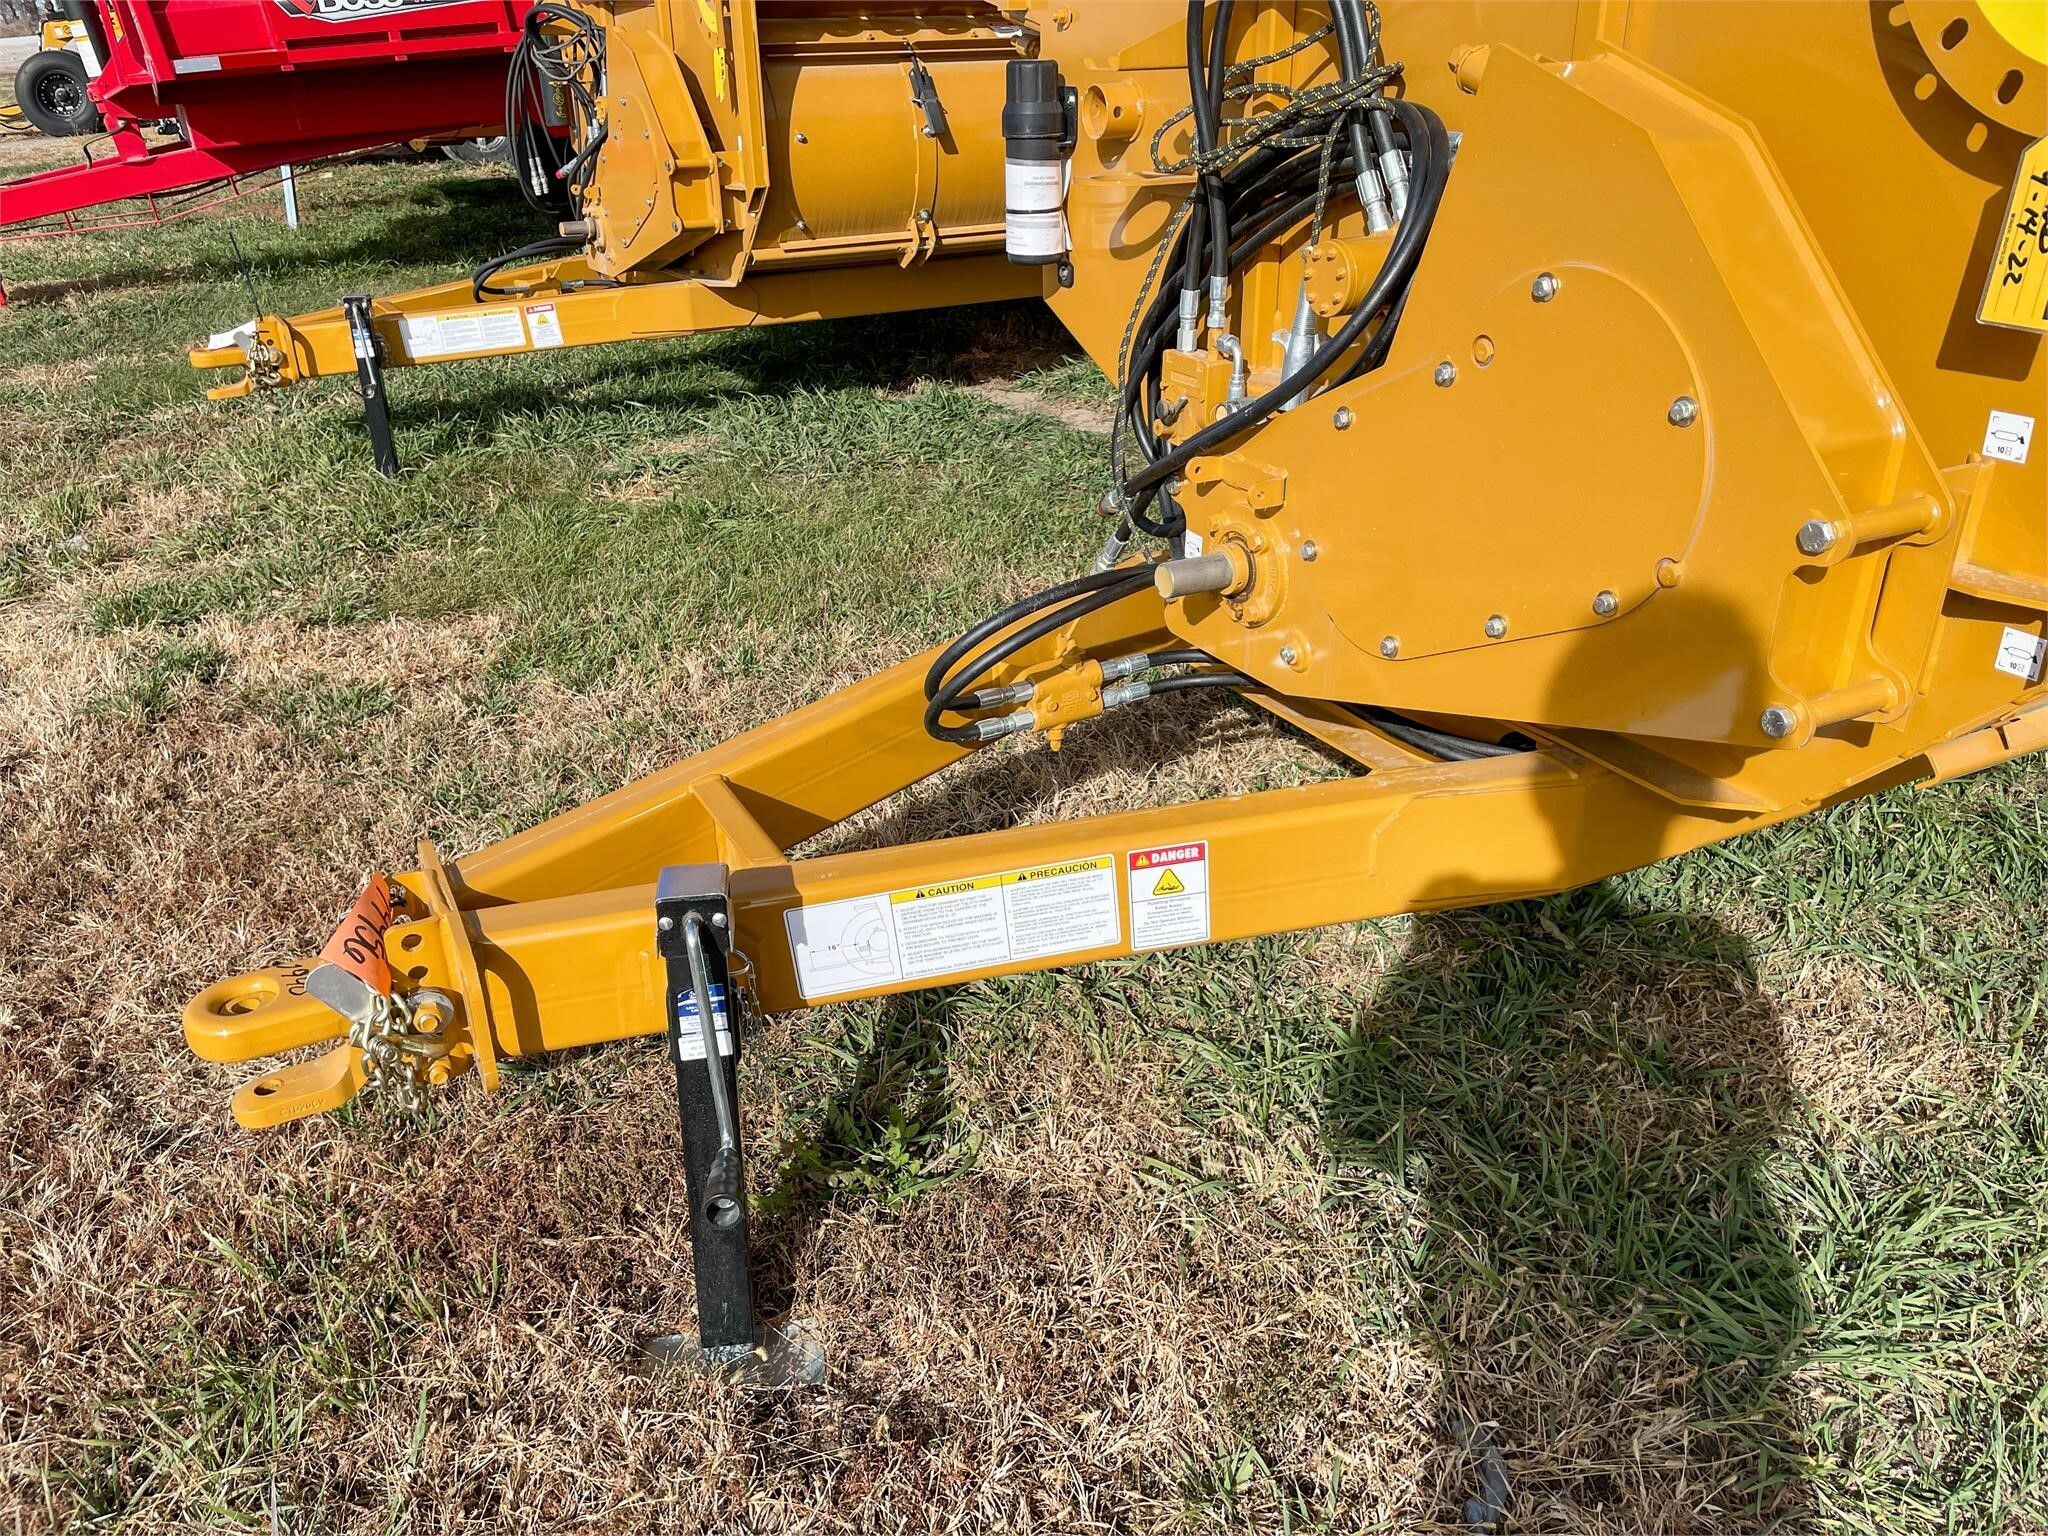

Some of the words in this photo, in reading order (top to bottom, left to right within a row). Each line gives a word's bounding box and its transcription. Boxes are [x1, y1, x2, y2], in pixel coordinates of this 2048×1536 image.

[1997, 446, 2005, 454] 10
[2009, 662, 2018, 670] 10
[1151, 847, 1200, 864] DANGER
[1029, 860, 1098, 880] PRECAUCIÓN
[928, 882, 974, 897] CAUTION
[827, 943, 840, 951] 16"
